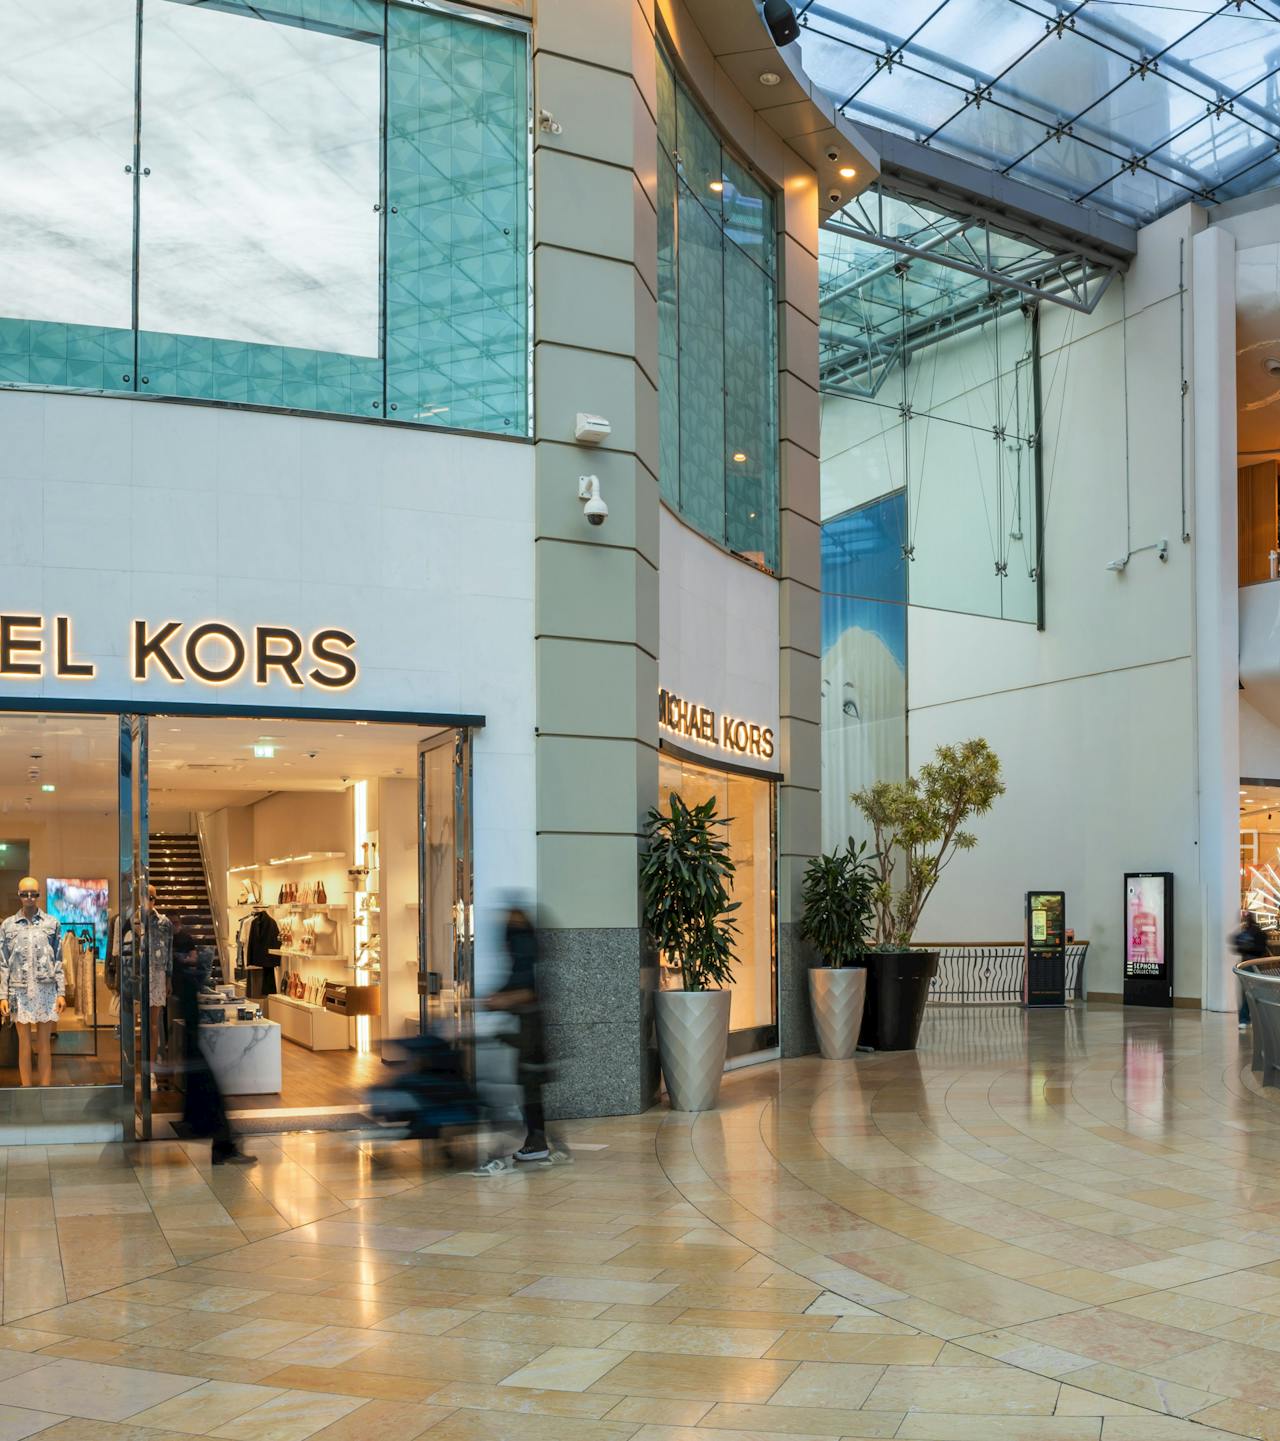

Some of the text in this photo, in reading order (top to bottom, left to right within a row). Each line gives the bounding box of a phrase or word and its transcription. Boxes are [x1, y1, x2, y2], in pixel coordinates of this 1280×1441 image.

[0, 615, 357, 688] EL KORS
[723, 716, 774, 758] KORS
